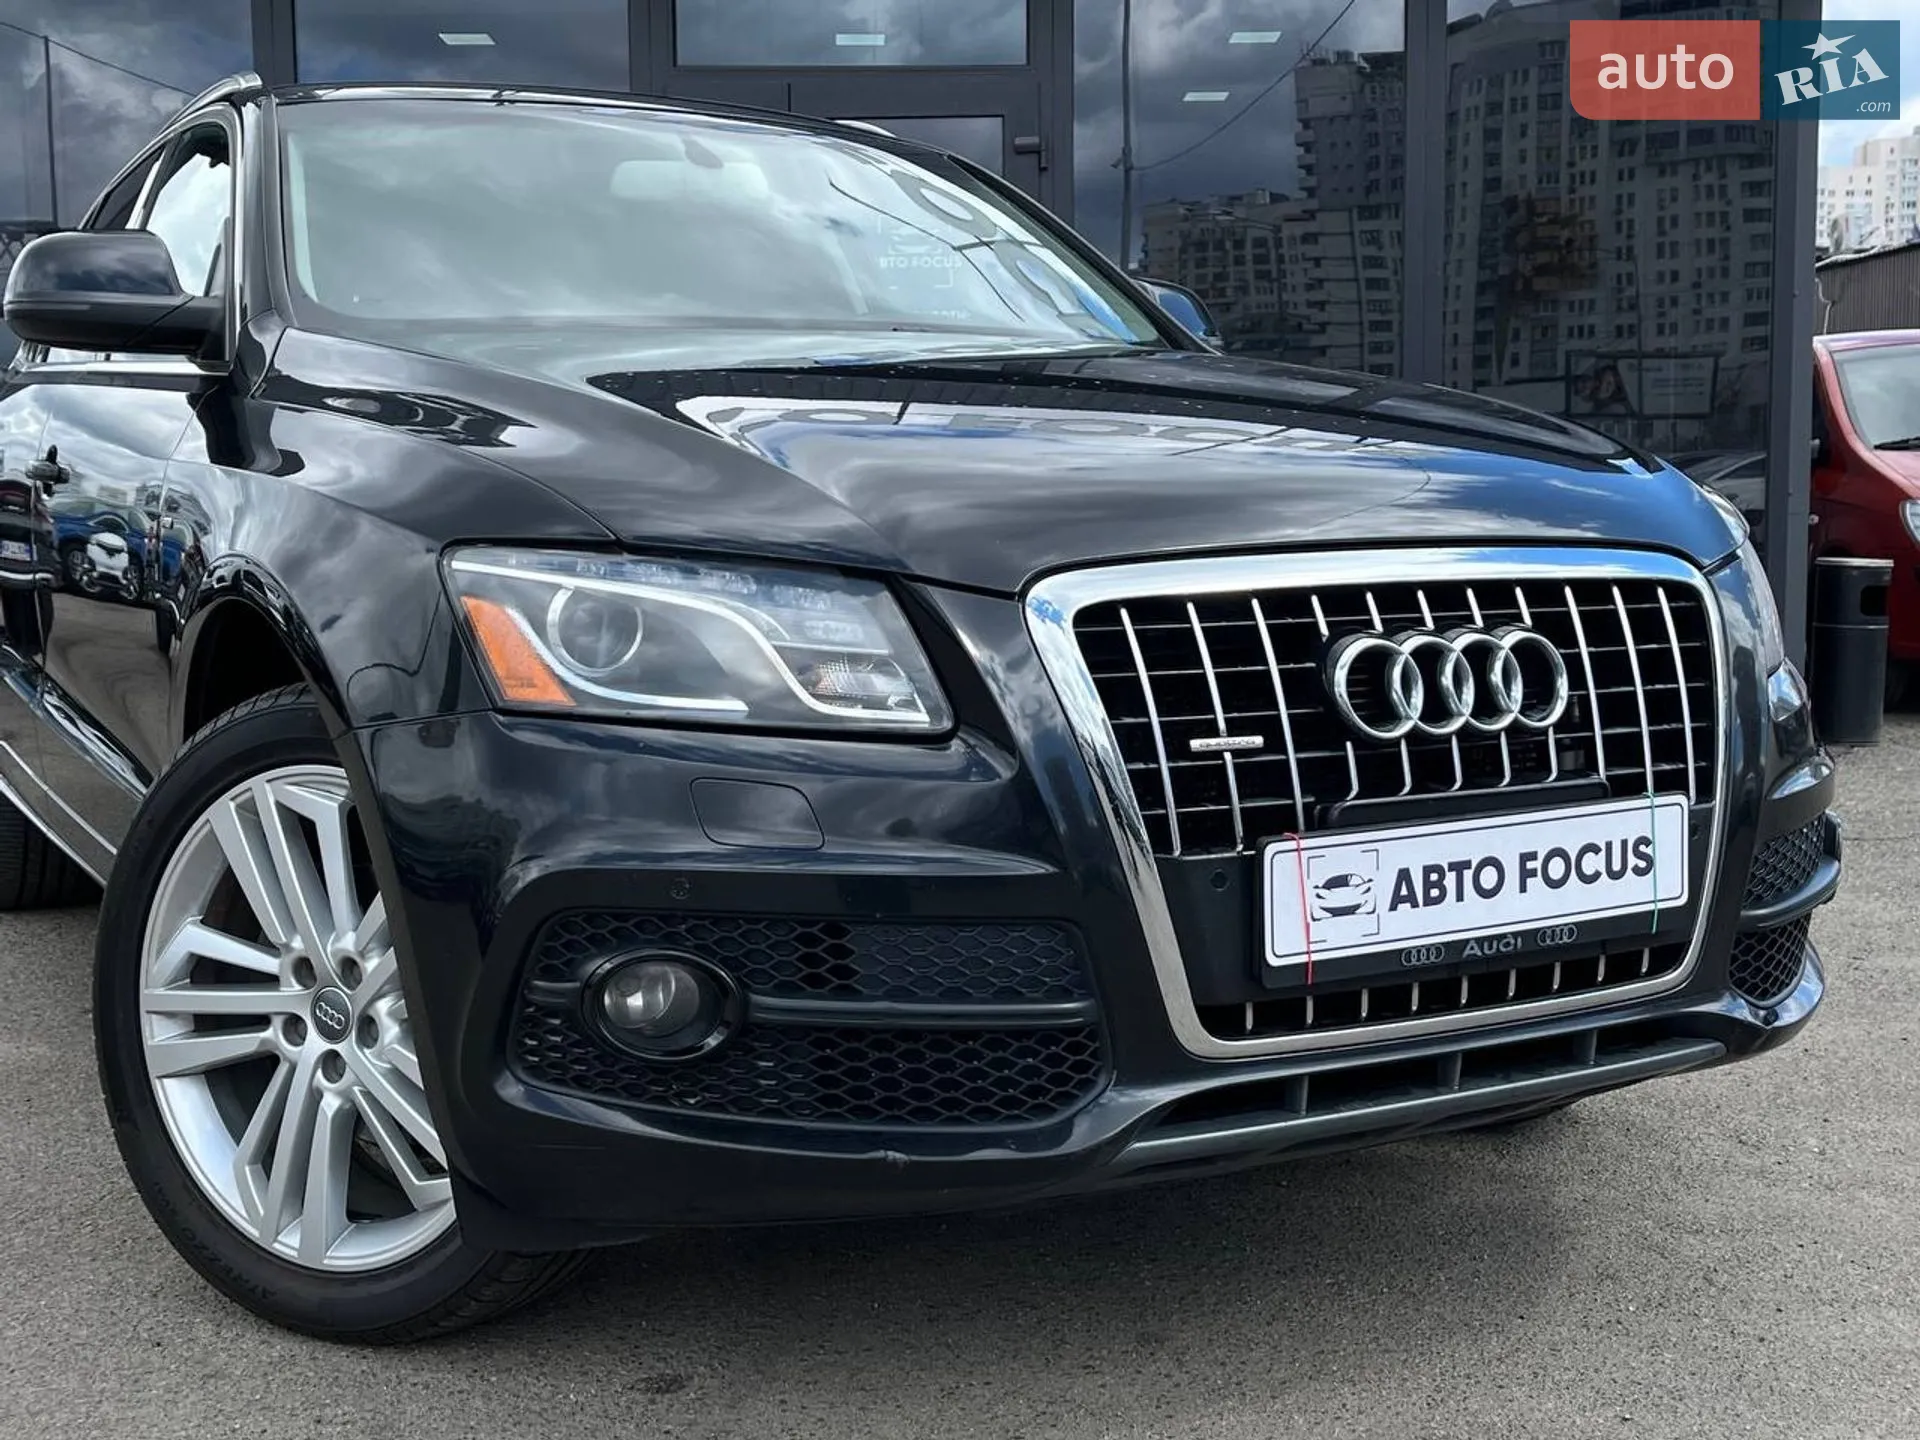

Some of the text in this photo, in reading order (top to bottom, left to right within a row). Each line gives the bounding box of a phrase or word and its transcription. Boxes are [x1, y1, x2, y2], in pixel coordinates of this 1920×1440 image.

[1389, 834, 1656, 912] АВТО FOCUS
[1463, 935, 1524, 958] Audi
